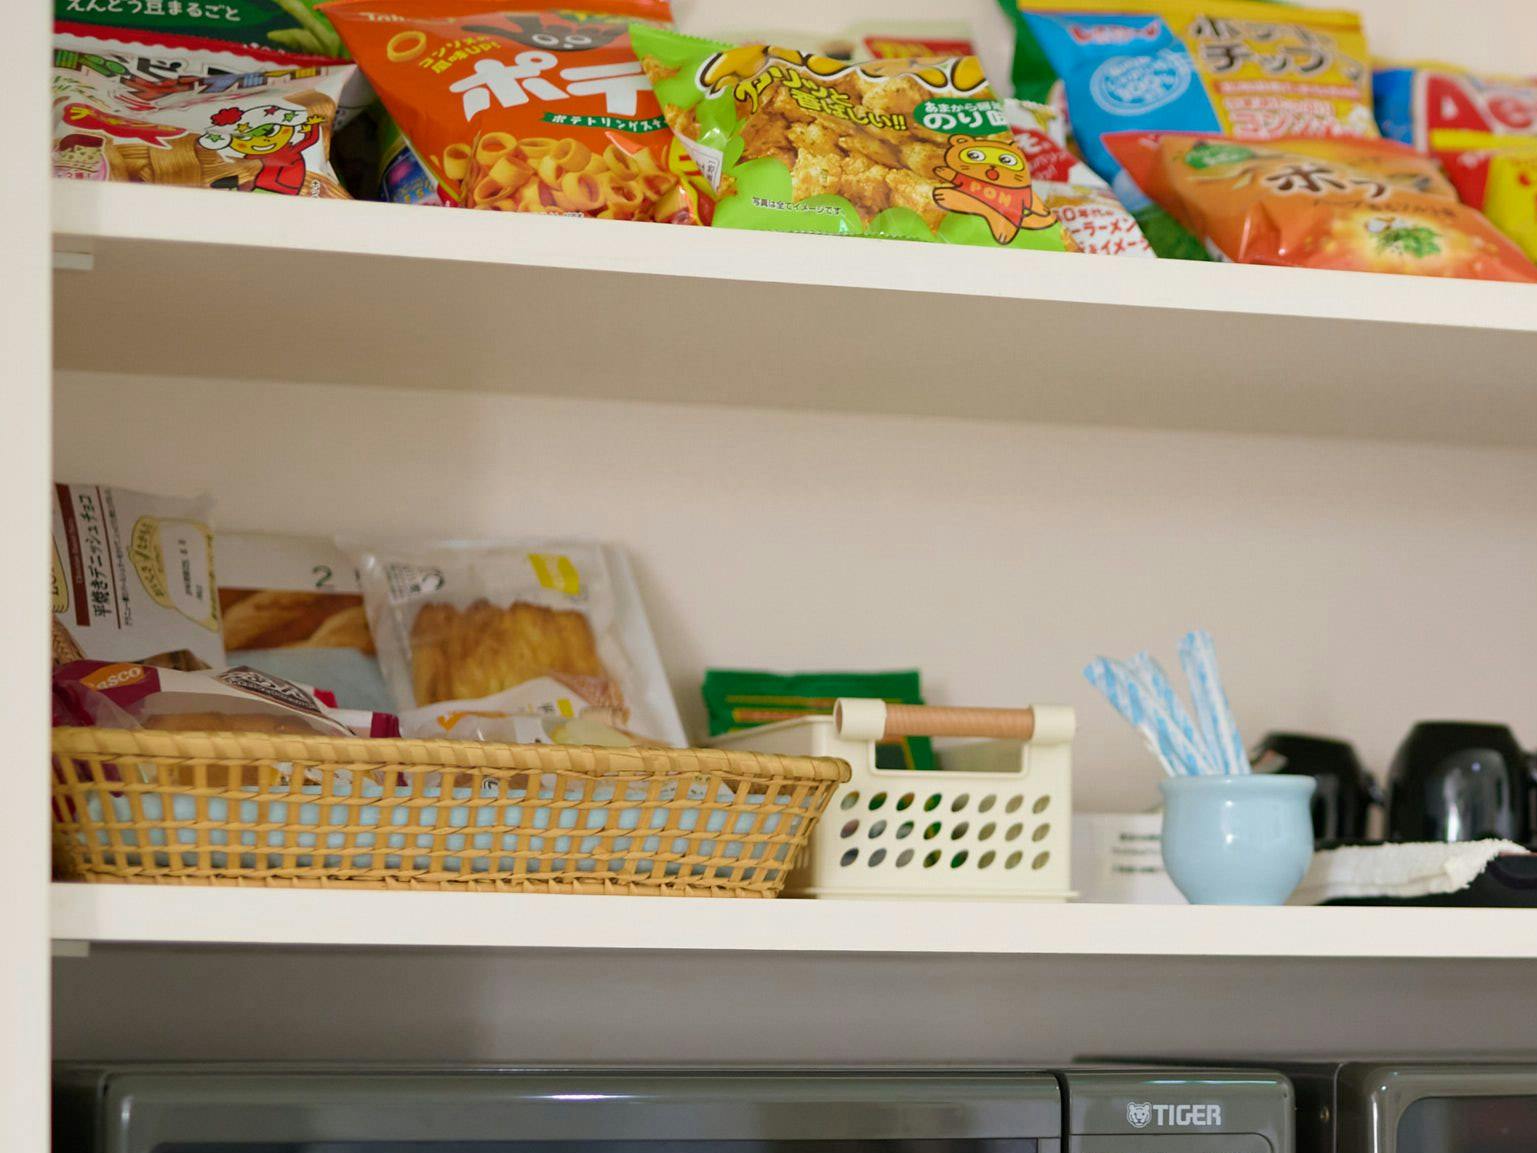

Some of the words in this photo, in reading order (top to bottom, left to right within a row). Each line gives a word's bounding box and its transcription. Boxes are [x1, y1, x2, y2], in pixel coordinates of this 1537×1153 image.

[67, 0, 241, 21] えんどう豆まるごと
[1153, 1104, 1221, 1126] TIGER
